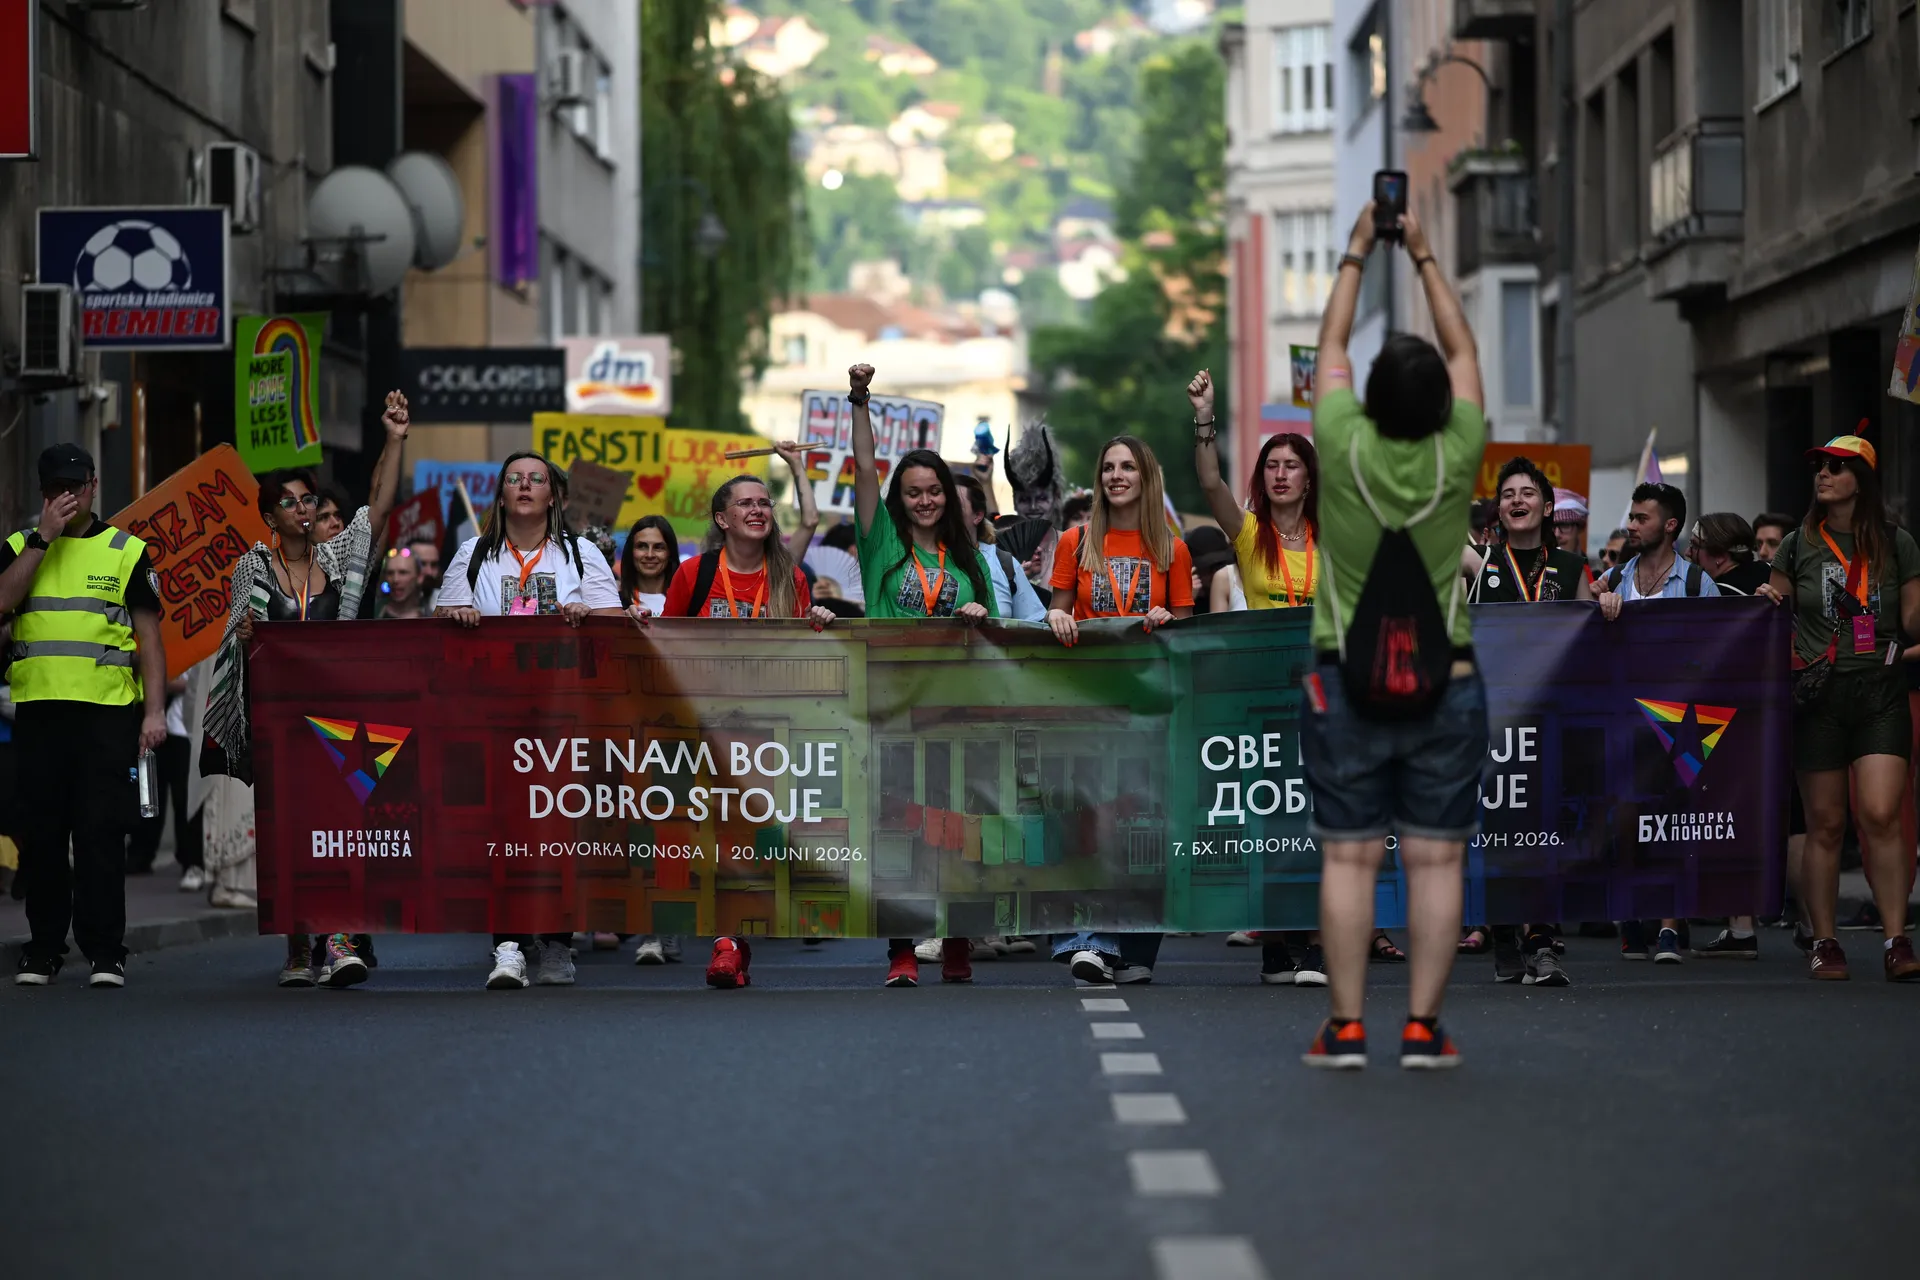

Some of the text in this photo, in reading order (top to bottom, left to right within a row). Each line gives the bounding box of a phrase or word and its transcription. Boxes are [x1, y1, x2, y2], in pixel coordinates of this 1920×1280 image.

[86, 291, 215, 308] sportska kladionica
[82, 308, 219, 338] REMIER
[250, 356, 285, 377] MORE
[590, 351, 645, 382] dm
[249, 376, 286, 405] LOVE
[251, 405, 287, 425] LESS
[251, 423, 288, 449] HATE
[543, 427, 660, 464] FAŠISTI
[86, 584, 119, 594] SECURITY
[87, 575, 120, 585] SWORD
[514, 738, 836, 777] SVE NAM BOJE
[1201, 733, 1281, 771] СВЕ
[530, 784, 822, 823] DOBRO STOJE
[1208, 778, 1314, 825] ДОБ
[1638, 815, 1669, 843] БХ
[1671, 812, 1734, 825] ПОВОРКА
[347, 829, 411, 841] POVORKA
[1471, 832, 1565, 848] ЈУН 2026.
[1671, 825, 1736, 841] ПОНОСА
[312, 830, 344, 858] BH
[347, 842, 412, 857] PONOSA
[487, 842, 867, 861] 7. BH. POVORKA PONOSA 20. JUNI 2026.
[1173, 837, 1316, 857] 7. БХ. ПОВОРКА
